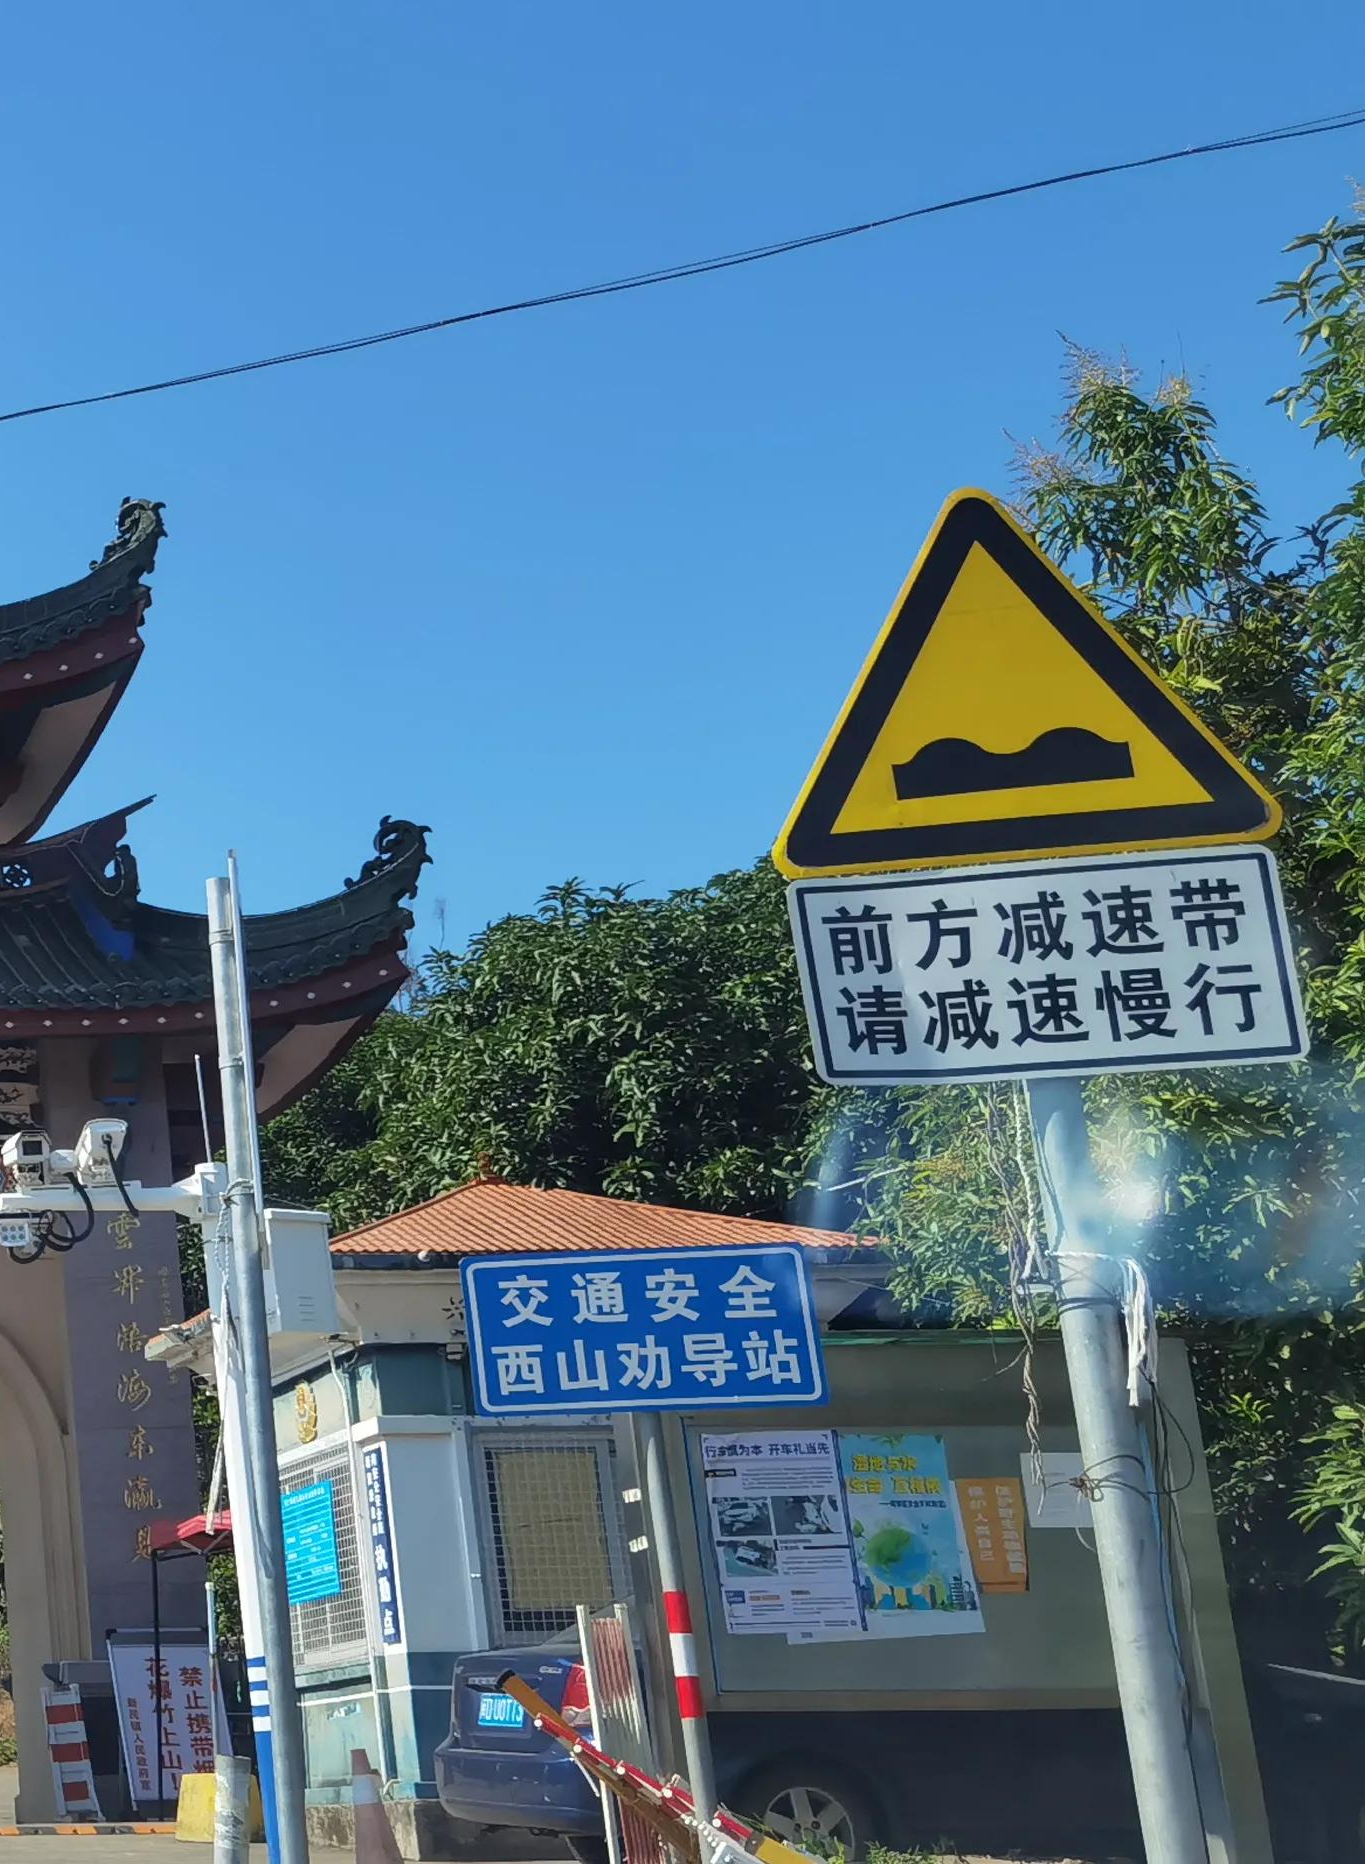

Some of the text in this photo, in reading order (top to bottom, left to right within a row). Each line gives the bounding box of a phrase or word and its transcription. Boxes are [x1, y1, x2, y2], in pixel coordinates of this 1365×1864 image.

[821, 878, 1246, 976] 前方减速带
[835, 962, 1263, 1054] 请减速慢行
[497, 1264, 777, 1328] 交通安全
[491, 1329, 802, 1395] 西山劝导站
